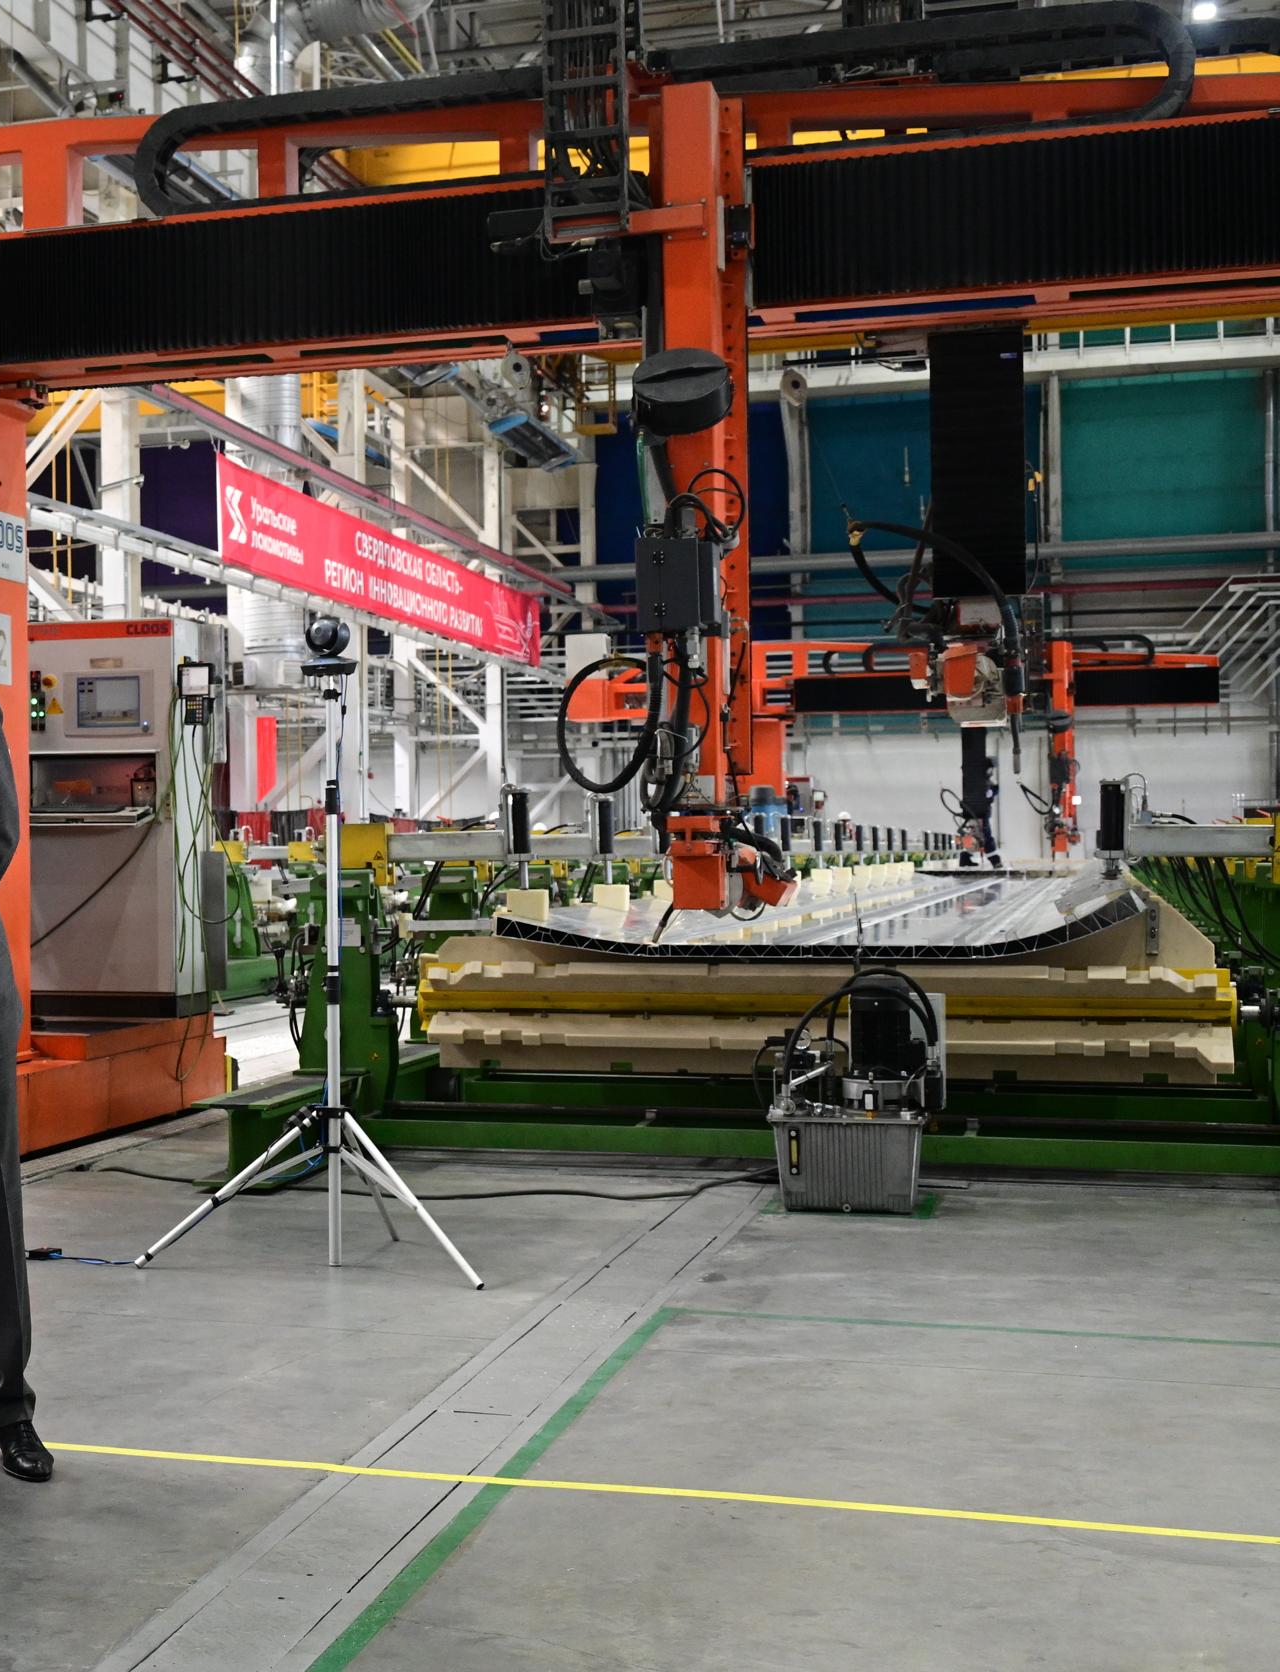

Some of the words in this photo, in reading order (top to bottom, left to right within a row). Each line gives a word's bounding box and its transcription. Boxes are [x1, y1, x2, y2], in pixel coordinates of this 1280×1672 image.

[251, 496, 297, 536] Уральские
[251, 530, 304, 565] локомотивы
[355, 531, 423, 580] СВЕРДЛОВСКАЯ
[324, 559, 364, 596] РЕГИОН
[126, 623, 168, 635] CLOOS
